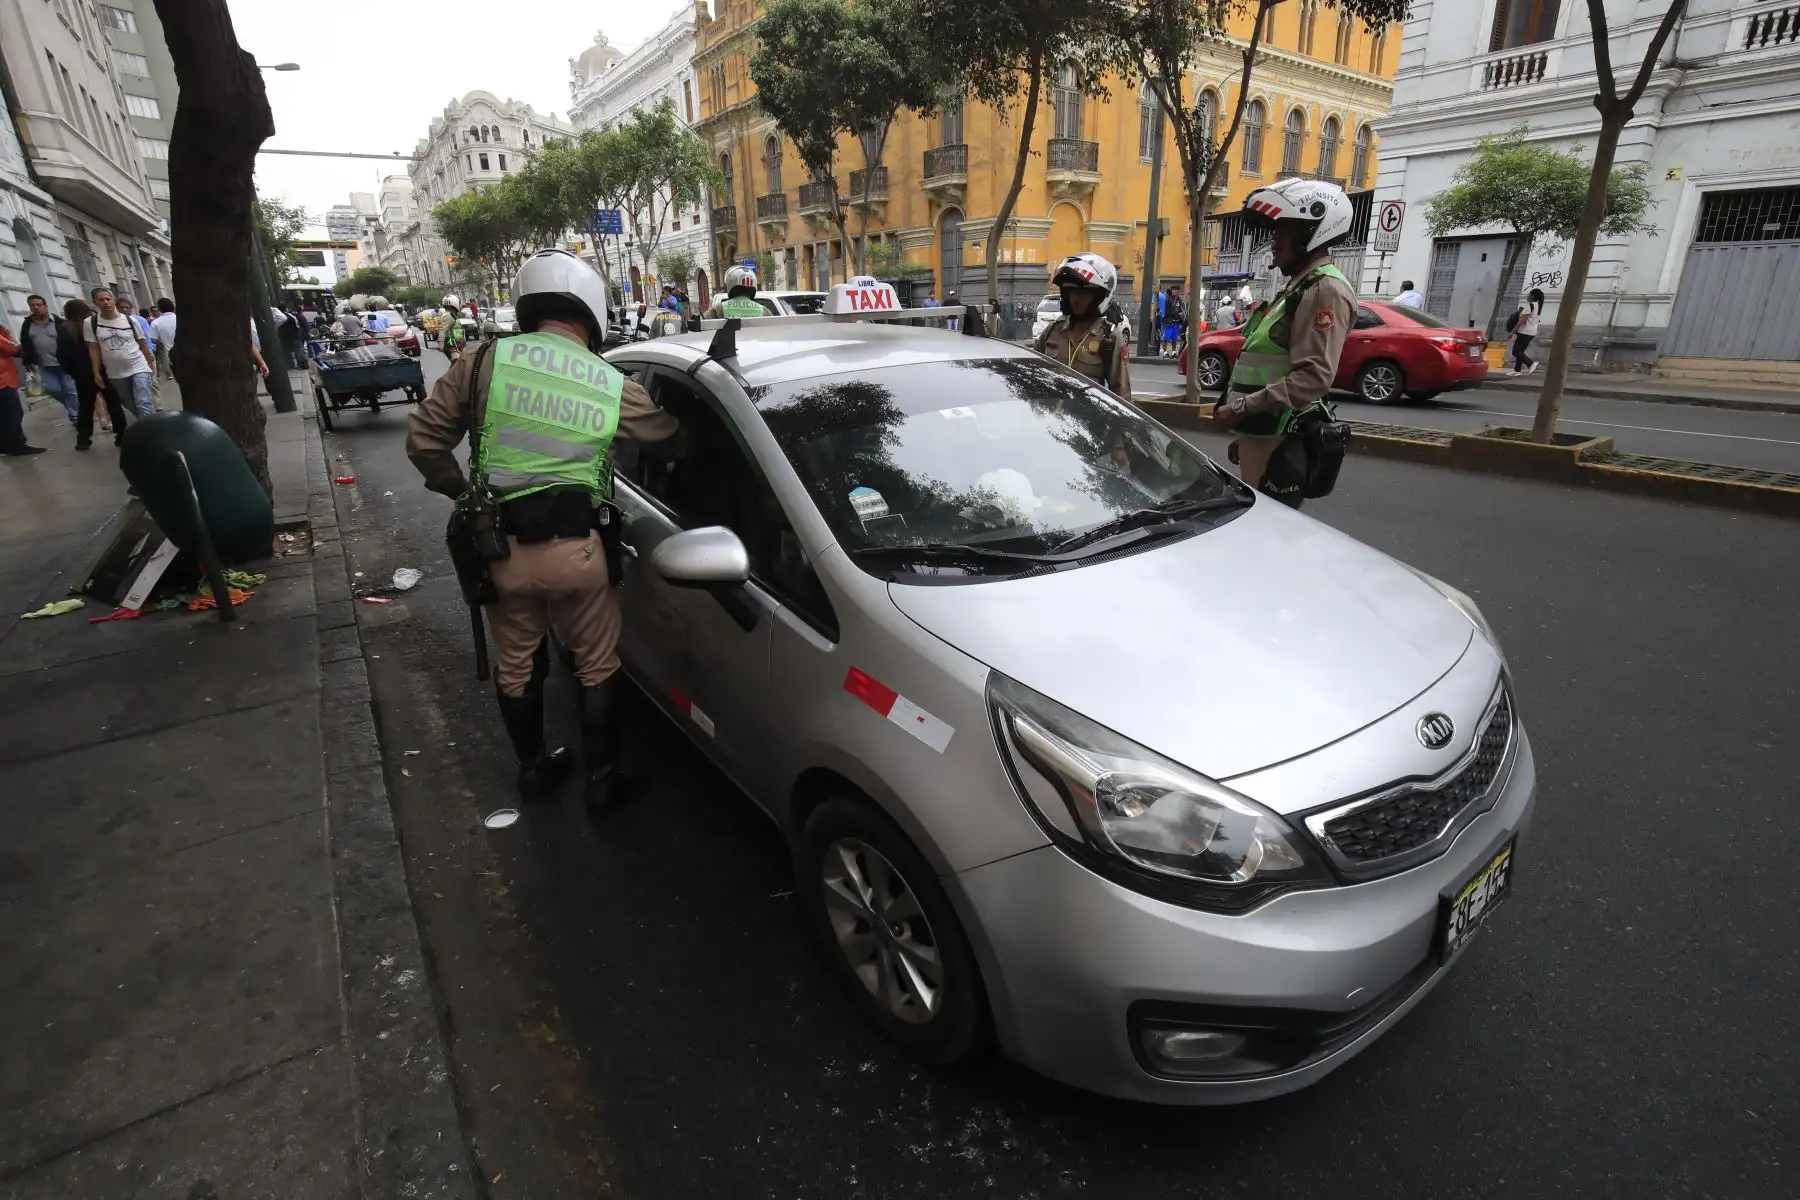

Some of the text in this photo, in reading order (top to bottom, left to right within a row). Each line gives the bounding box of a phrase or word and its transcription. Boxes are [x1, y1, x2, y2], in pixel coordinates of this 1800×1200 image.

[1299, 192, 1339, 206] TRANSITO
[728, 300, 762, 309] POLICIA
[846, 289, 893, 310] TAXI
[510, 343, 609, 390] POLICIA
[505, 383, 606, 432] TRANSITO
[1422, 715, 1453, 744] KIA
